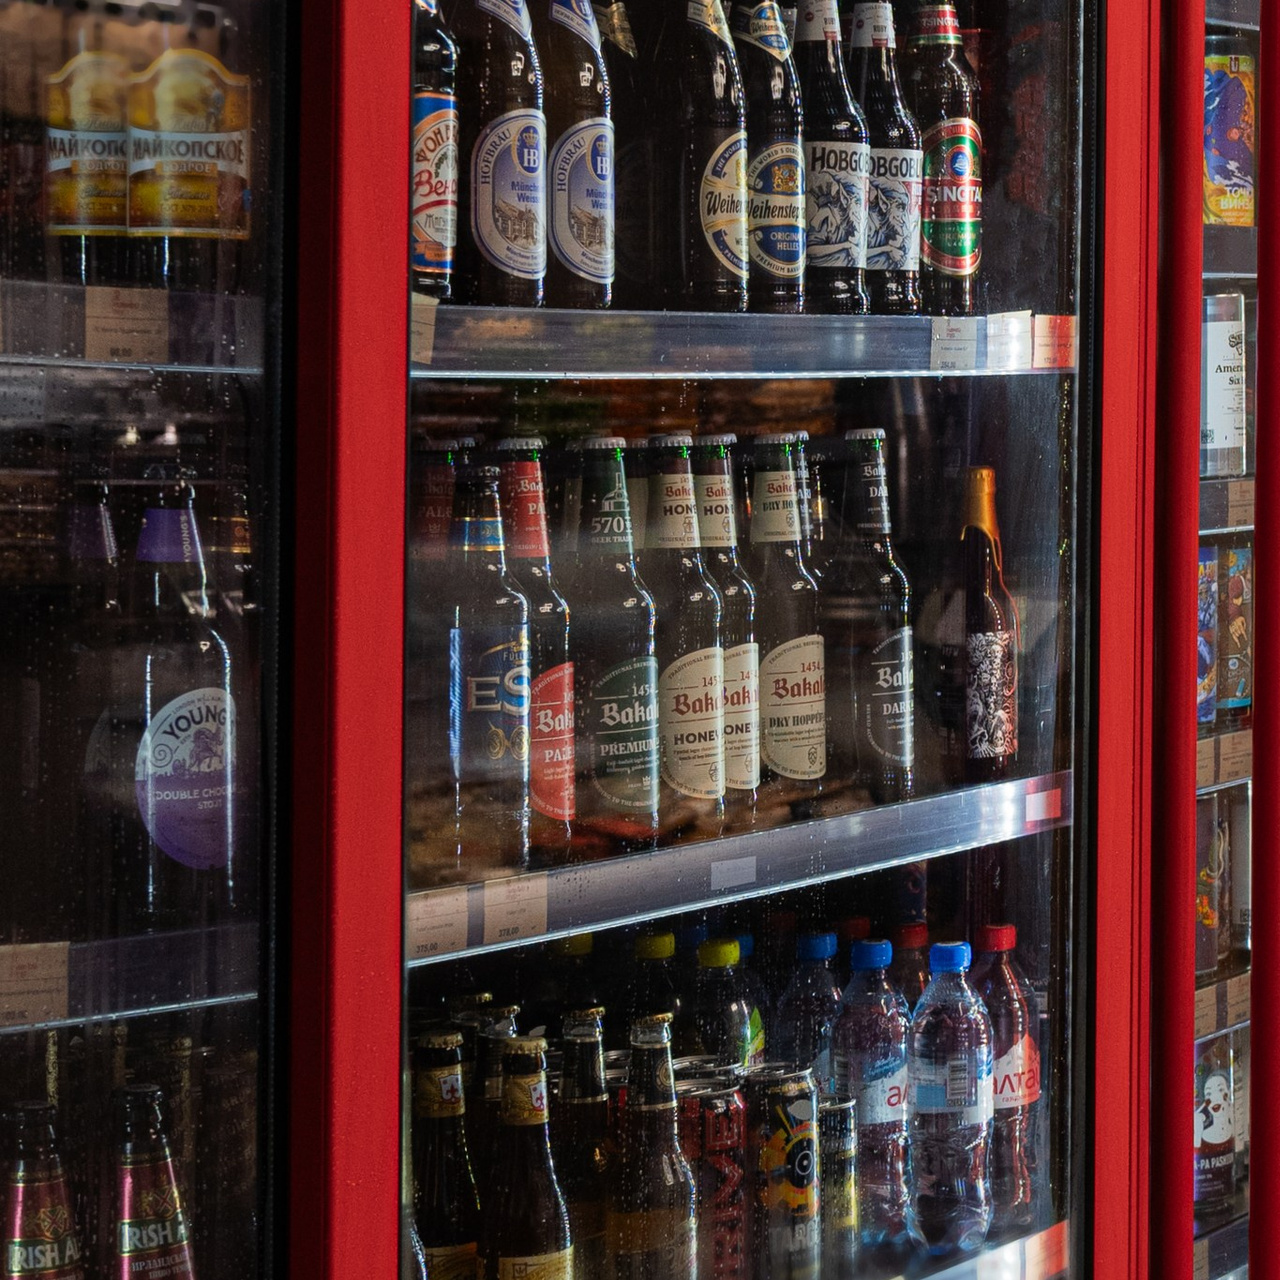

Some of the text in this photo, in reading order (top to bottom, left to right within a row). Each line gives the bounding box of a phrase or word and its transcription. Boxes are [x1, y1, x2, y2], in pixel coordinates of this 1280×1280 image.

[480, 128, 513, 185] HOFBRÄU
[523, 149, 539, 168] HB
[557, 137, 586, 193] HOFBRÄU
[769, 715, 789, 729] DRY
[155, 788, 200, 802] DOUBLE
